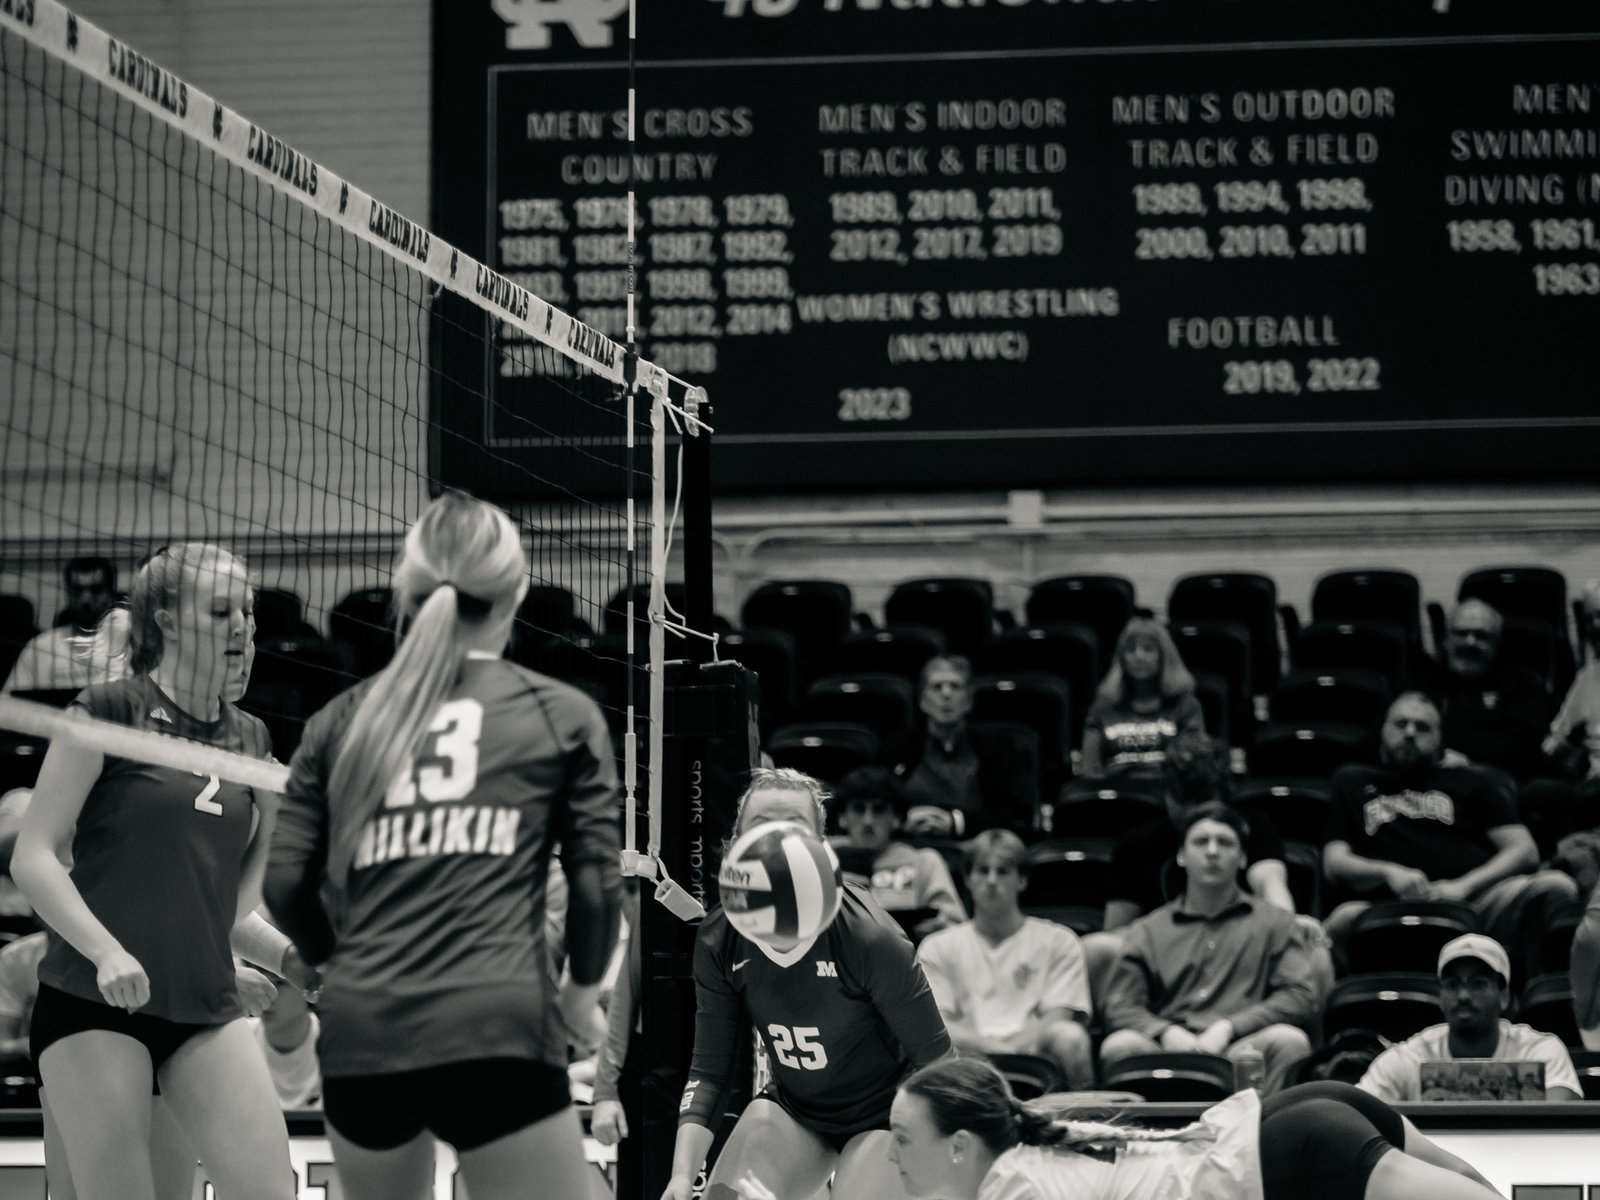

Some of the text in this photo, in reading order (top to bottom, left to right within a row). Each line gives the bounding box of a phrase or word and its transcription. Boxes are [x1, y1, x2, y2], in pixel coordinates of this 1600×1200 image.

[818, 98, 1067, 133] MEN'S INDOOR
[1112, 87, 1395, 125] MEN'S OUTDOOR
[527, 107, 753, 141] MEN'S CROSS
[820, 142, 1067, 178] TRACK & FIELD
[1128, 133, 1379, 169] TRACK & FIELD
[109, 37, 188, 119] CARDINALS
[247, 124, 318, 196] CARDINALS
[369, 199, 430, 264] CARDINALS
[476, 263, 529, 322] CARDINALS
[561, 153, 718, 185] COUNTRY
[1445, 173, 1564, 206] DIVING
[1300, 222, 1367, 256] 2011
[797, 287, 1120, 323] WOMEN'S WRESTLING
[888, 330, 1029, 365] (NCWWC)
[1168, 315, 1342, 349] FOOTBALL
[838, 387, 911, 421] 2023
[816, 961, 838, 977] M
[767, 1023, 828, 1070] 25
